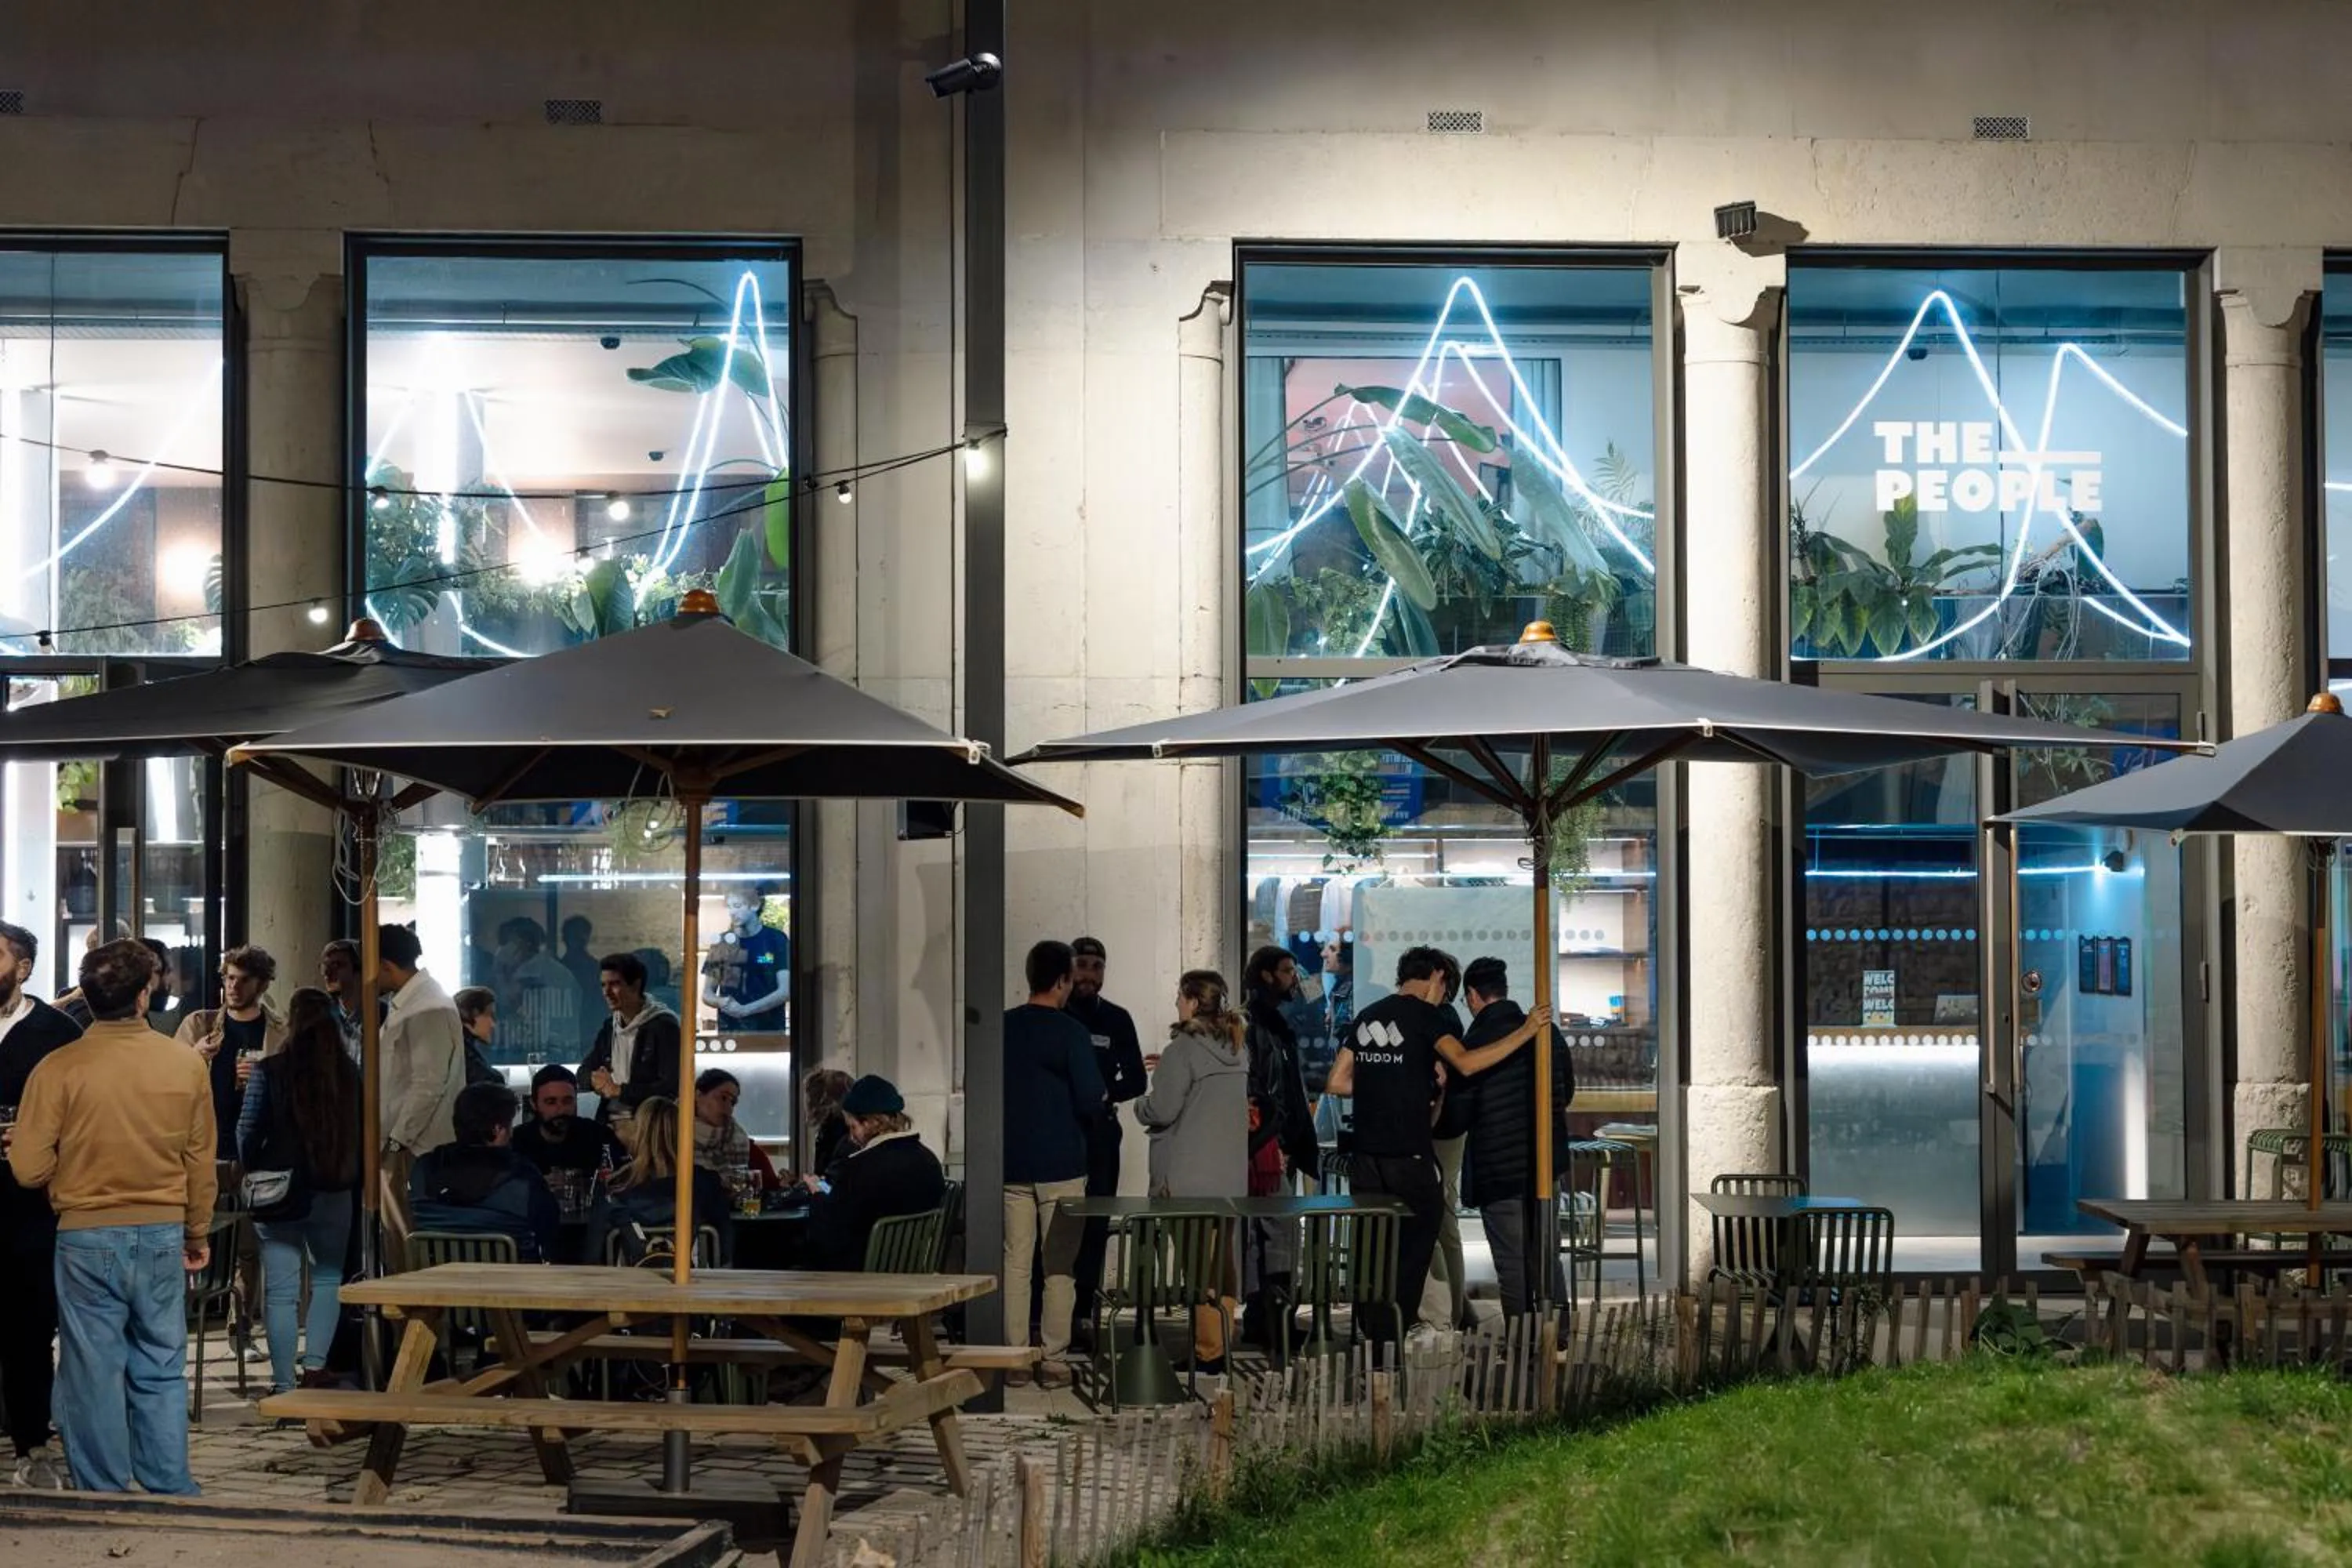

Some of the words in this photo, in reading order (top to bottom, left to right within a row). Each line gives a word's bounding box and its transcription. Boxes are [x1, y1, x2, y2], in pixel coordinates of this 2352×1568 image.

[1874, 421, 1993, 464] THE
[1875, 469, 2103, 512] PEOPLE
[1393, 1053, 1403, 1065] M
